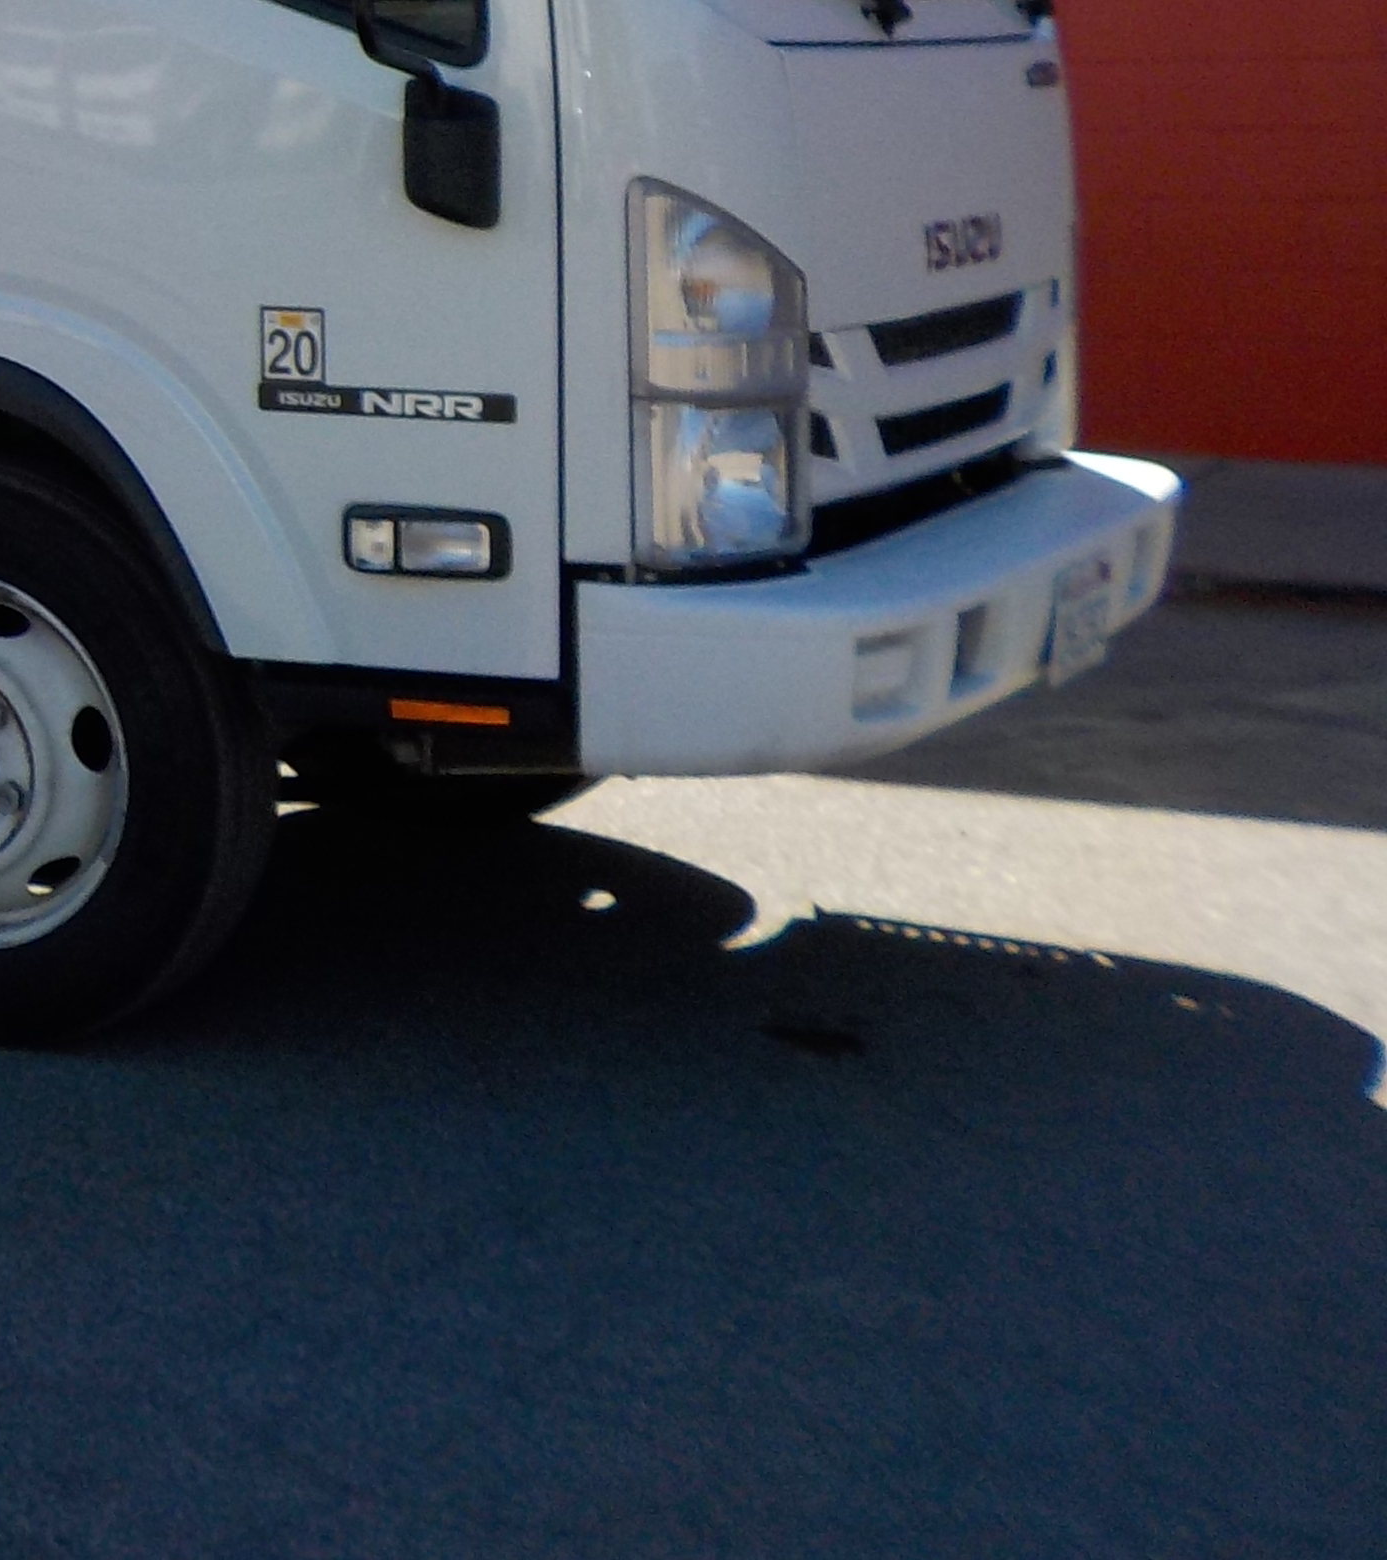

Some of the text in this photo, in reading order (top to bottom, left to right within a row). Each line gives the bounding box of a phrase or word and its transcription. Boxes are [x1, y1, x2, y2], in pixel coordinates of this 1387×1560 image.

[268, 328, 319, 376] 20
[279, 391, 483, 419] ISUZU NRR
